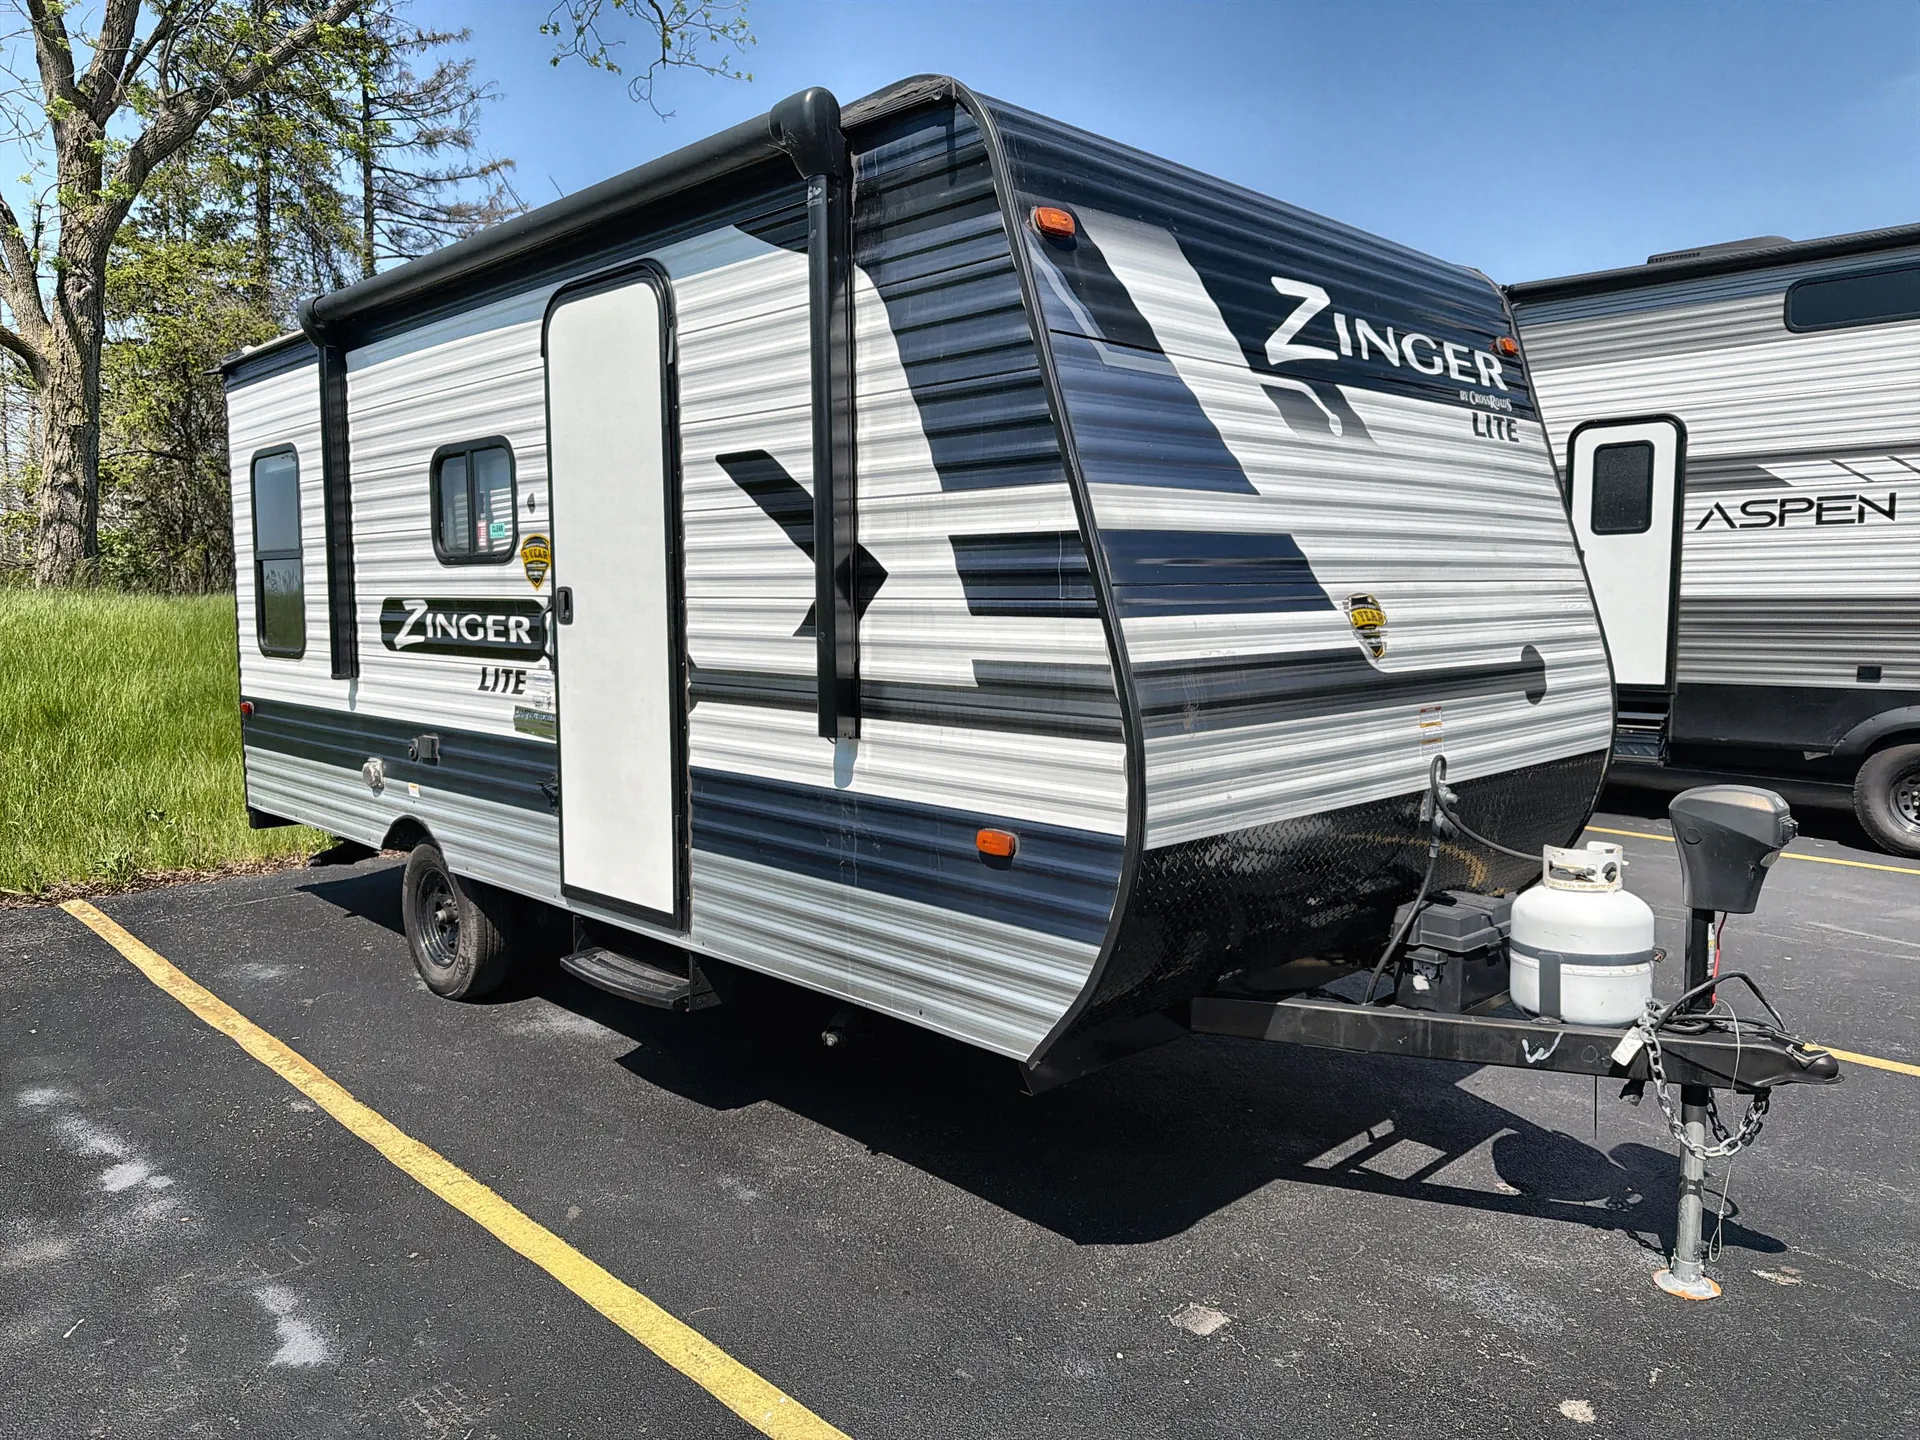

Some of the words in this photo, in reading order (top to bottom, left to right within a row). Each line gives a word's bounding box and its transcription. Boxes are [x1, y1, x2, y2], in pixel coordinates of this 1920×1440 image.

[1264, 276, 1509, 391] ZINGER
[1460, 390, 1469, 401] BY
[1471, 411, 1520, 443] LITE
[1694, 492, 1897, 530] ASPEN
[394, 599, 532, 650] ZINGER
[1357, 610, 1384, 623] YEAR
[477, 667, 527, 695] LITE
